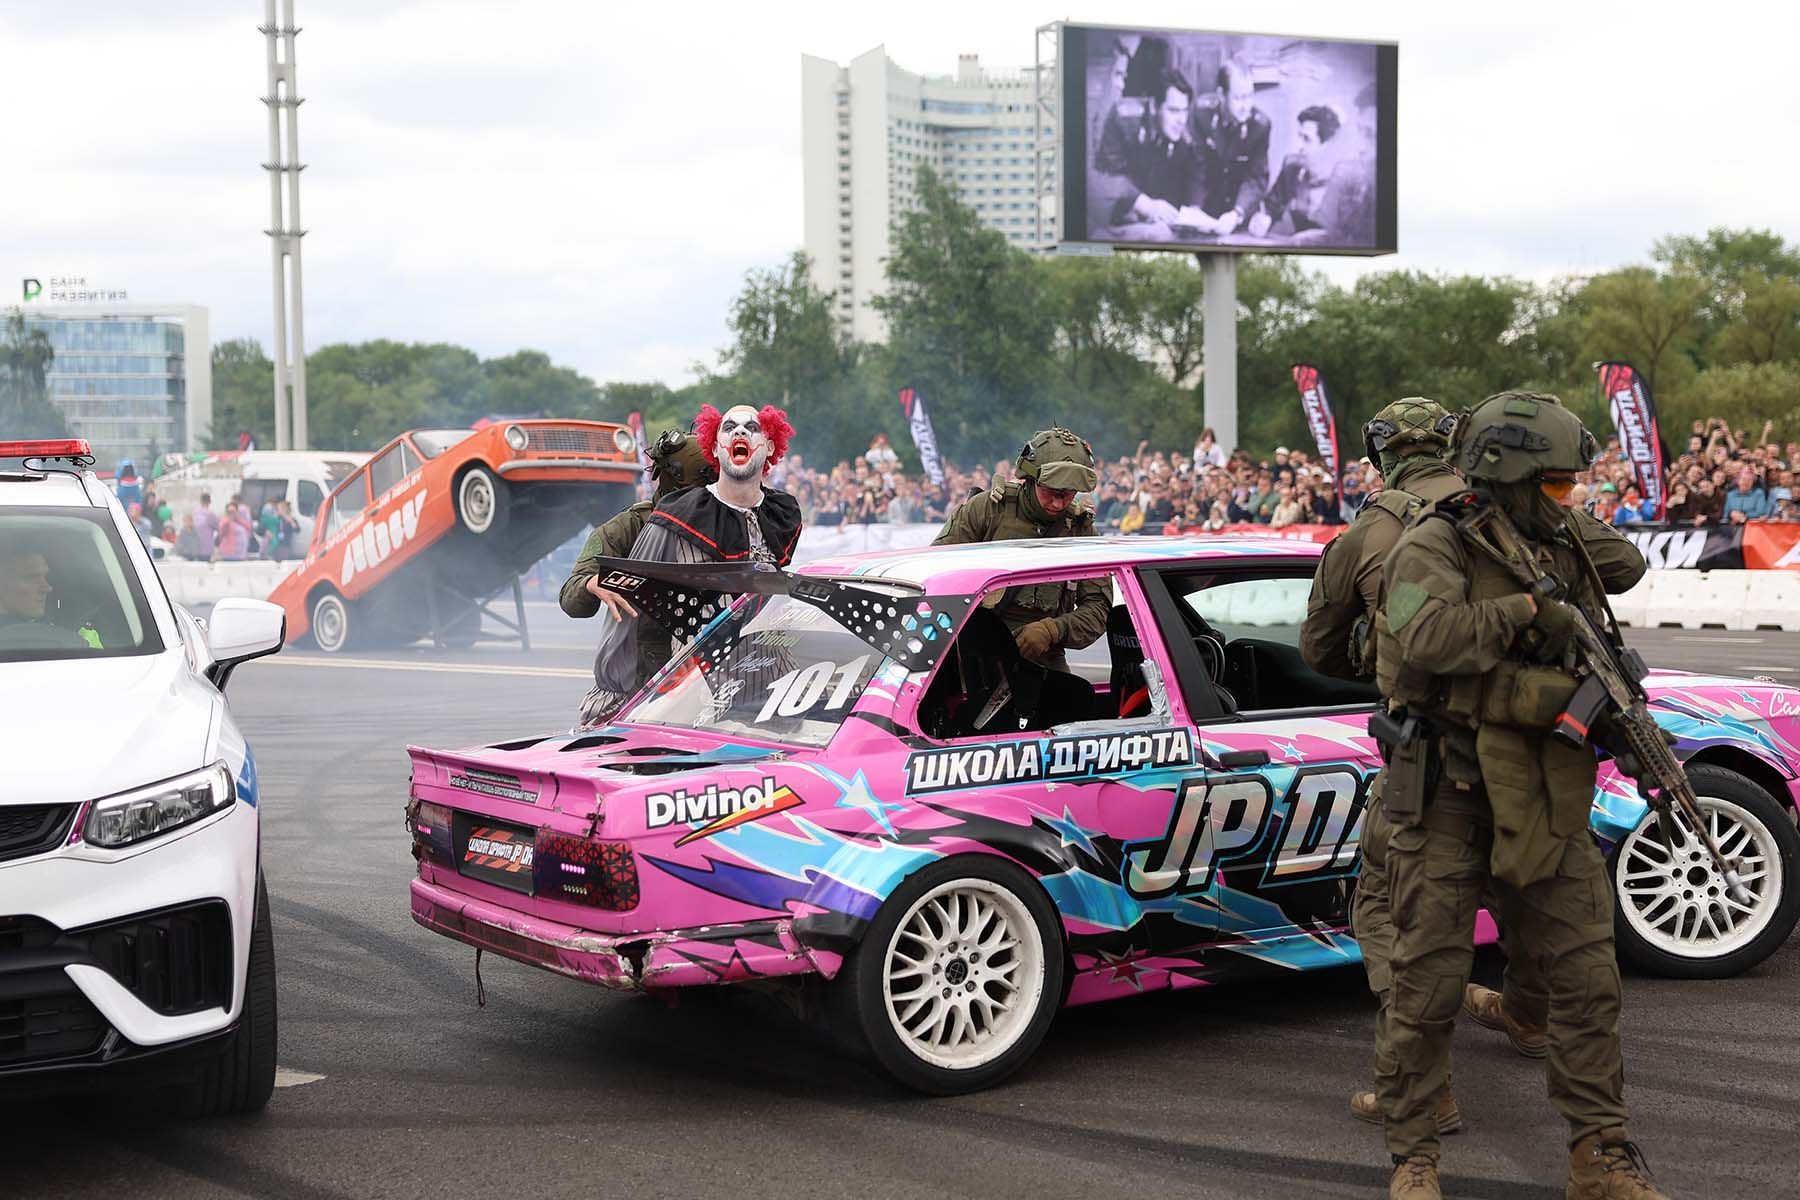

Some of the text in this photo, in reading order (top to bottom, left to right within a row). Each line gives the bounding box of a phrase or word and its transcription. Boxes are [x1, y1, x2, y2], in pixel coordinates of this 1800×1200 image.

[754, 654, 871, 723] 101
[912, 731, 1189, 790] ШКОЛА ДРИФТА
[646, 777, 776, 828] Divinol
[1128, 781, 1268, 893] JP
